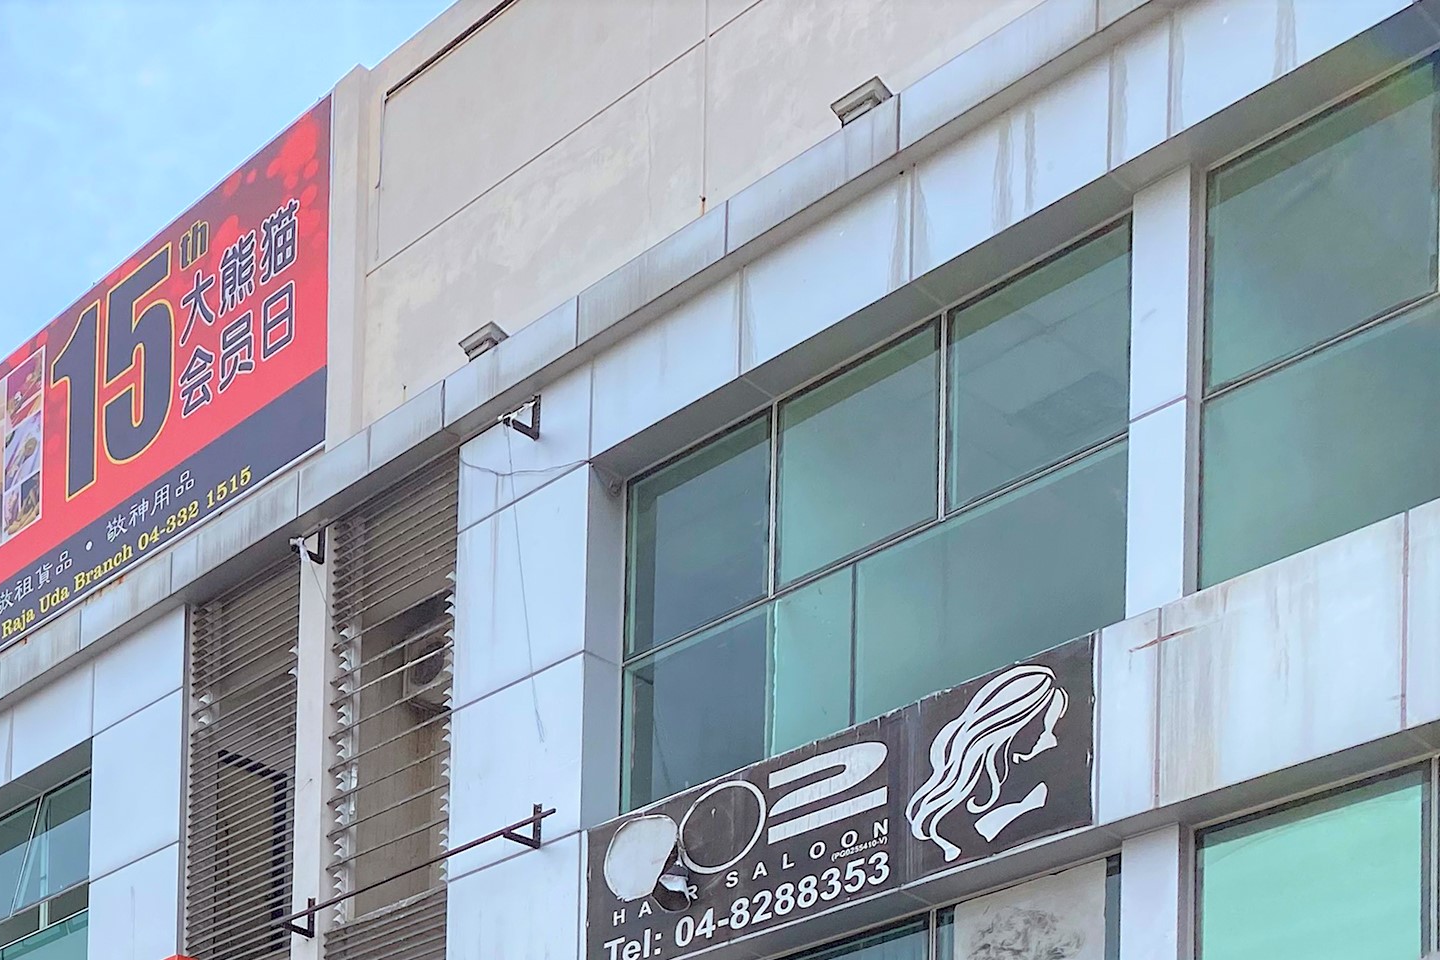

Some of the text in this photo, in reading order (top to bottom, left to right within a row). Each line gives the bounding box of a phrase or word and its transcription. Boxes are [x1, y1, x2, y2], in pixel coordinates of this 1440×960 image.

[180, 198, 300, 347] 大熊猫
[180, 279, 296, 419] 会员日
[1, 607, 36, 641] Raja
[39, 584, 70, 615] Uda
[74, 544, 133, 594] Branch
[137, 500, 199, 552] 04-332
[206, 465, 252, 509] 1515
[612, 818, 889, 927] HAR SALOON
[674, 851, 891, 948] 04-8288353
